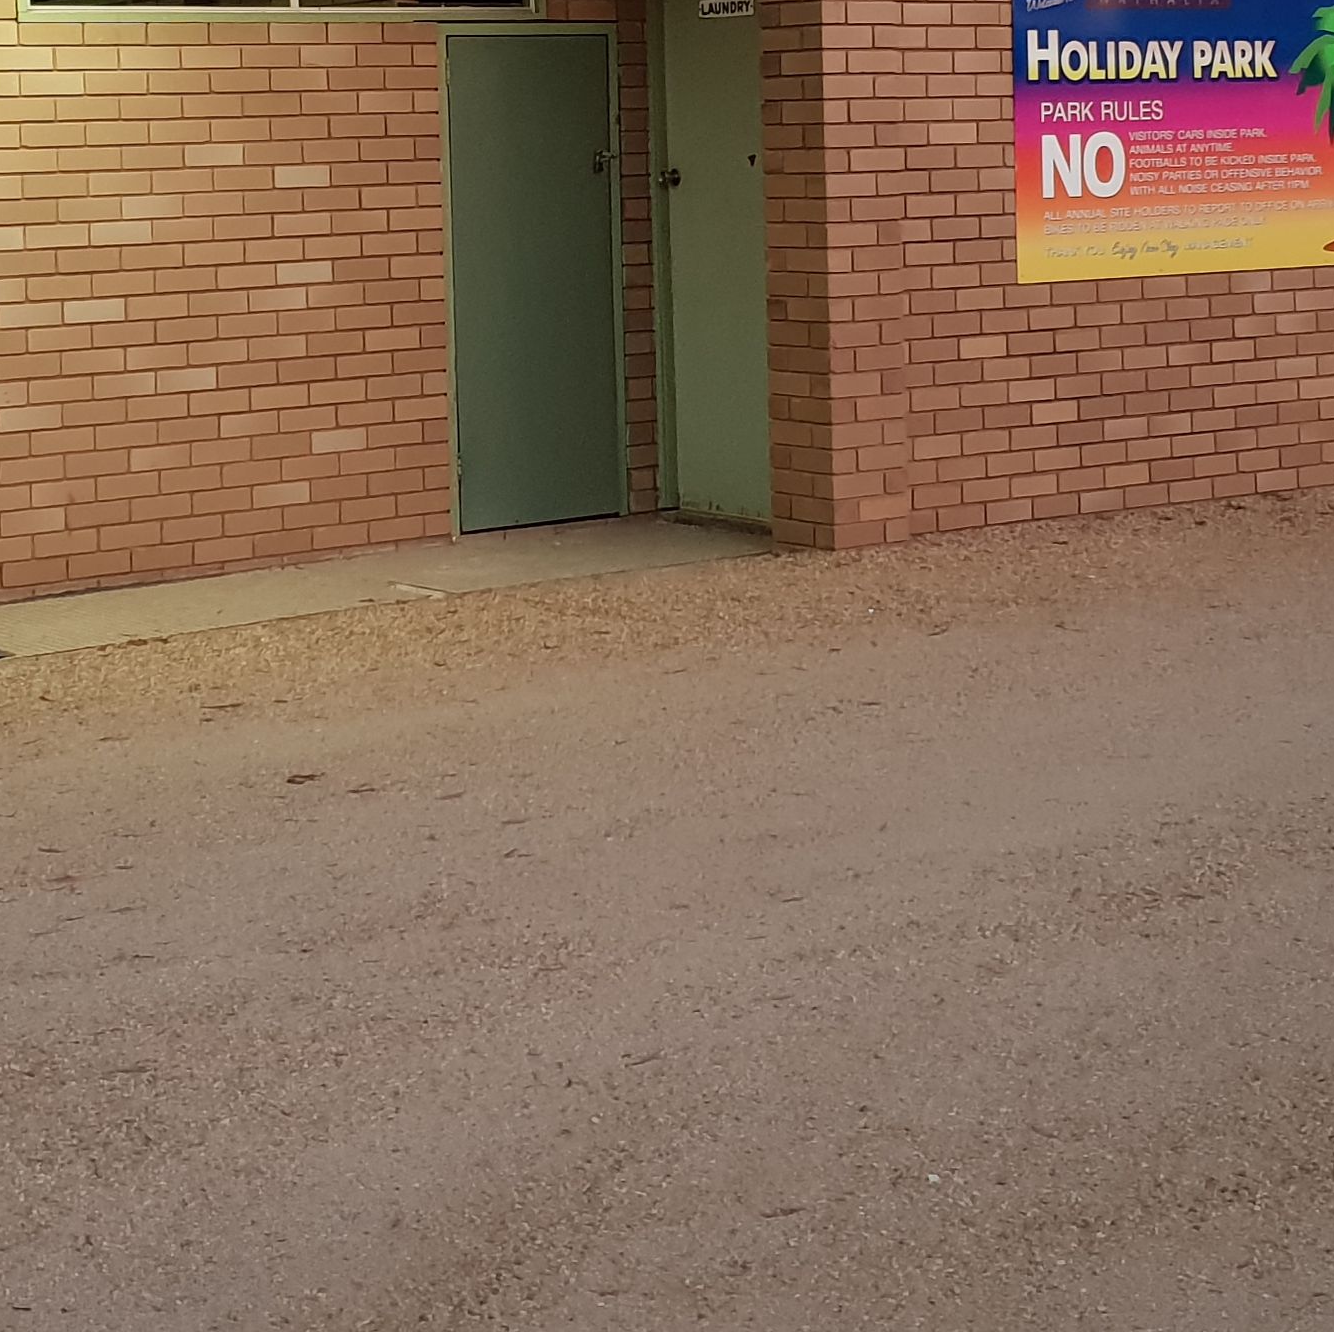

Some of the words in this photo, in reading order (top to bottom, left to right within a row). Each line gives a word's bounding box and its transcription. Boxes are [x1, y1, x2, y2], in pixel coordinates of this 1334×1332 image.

[701, 0, 751, 15] LAUNDRY
[1026, 29, 1184, 81] HOLIDAY
[1193, 39, 1278, 79] PARK
[1040, 101, 1094, 123] PARK
[1101, 100, 1164, 122] RULES
[1178, 130, 1204, 140] CARS
[1206, 129, 1237, 139] INSIDE
[1130, 144, 1173, 154] ANIMALS
[1176, 144, 1187, 153] AT
[1041, 131, 1127, 199] NO
[1130, 157, 1186, 168] FOOTBALLS
[1189, 157, 1202, 166] TO
[1205, 156, 1217, 166] BE
[1221, 155, 1255, 165] KICKED
[1258, 154, 1288, 164] INSIDE
[1130, 171, 1159, 182] NOISY
[1162, 170, 1202, 181] PARTIES
[1204, 170, 1218, 179] OR
[1221, 168, 1272, 179] OFFENSIVE
[1130, 185, 1156, 195] WITH
[1158, 185, 1175, 195] ALL
[1178, 183, 1207, 193] NOISE
[1210, 182, 1253, 192] CEASING
[1256, 181, 1285, 190] AFTER
[1043, 211, 1062, 221] ALL
[1066, 209, 1107, 220] ANNUAL
[1110, 207, 1131, 218] SITE
[1133, 205, 1180, 217] HOLDERS
[1183, 205, 1196, 215] TO
[1199, 202, 1236, 214] REPORT
[1254, 200, 1288, 212] OFFICE
[1291, 199, 1305, 209] ON
[1094, 223, 1106, 233] BE
